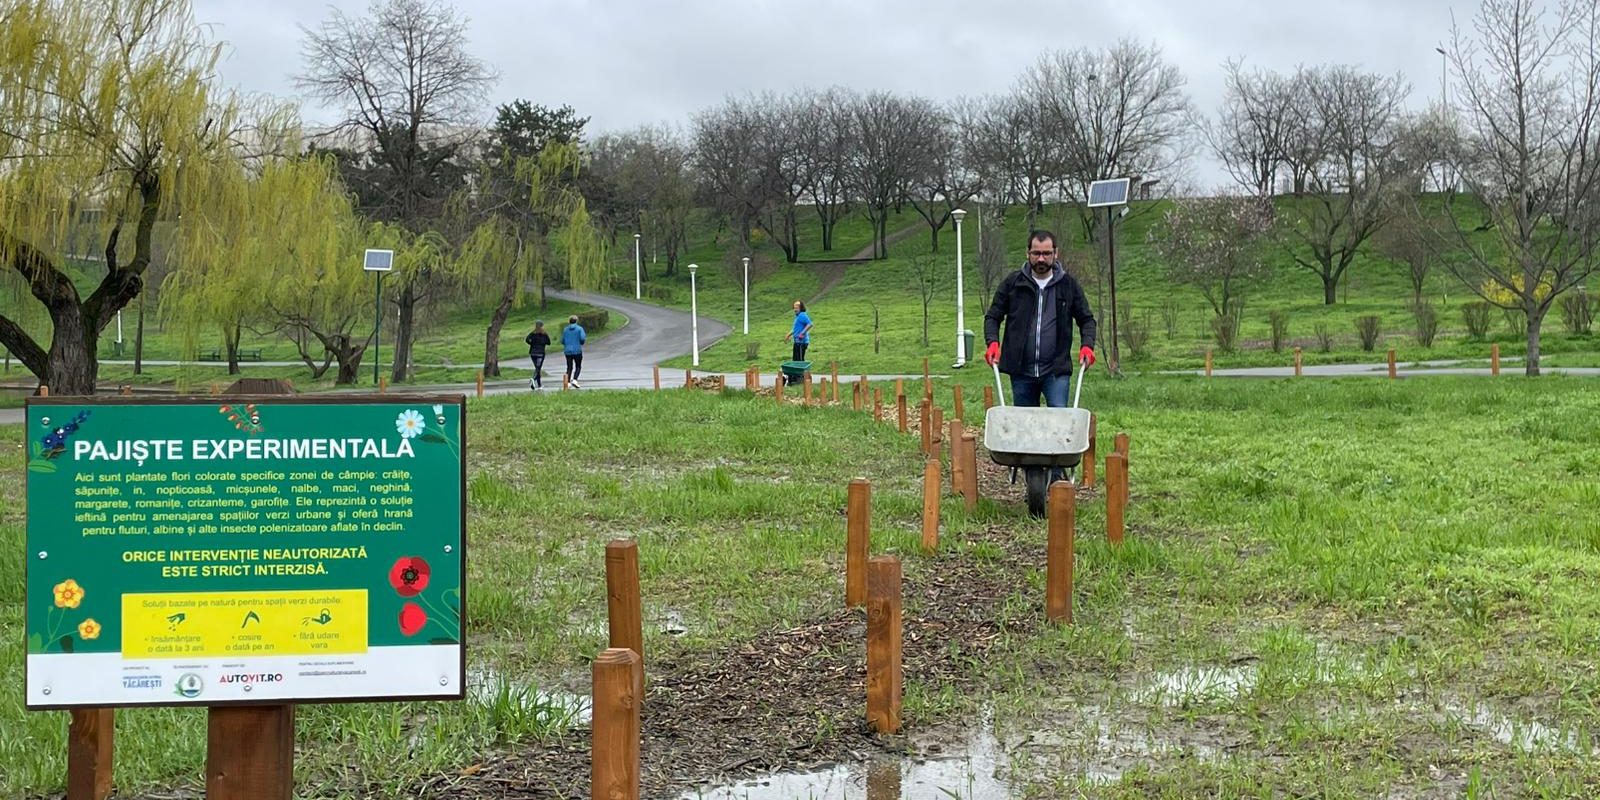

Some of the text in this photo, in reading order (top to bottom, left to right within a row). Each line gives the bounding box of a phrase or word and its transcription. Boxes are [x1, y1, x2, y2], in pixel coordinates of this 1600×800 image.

[74, 440, 184, 467] PAJIȘTE
[75, 473, 94, 482] Aici
[99, 473, 122, 482] sunt
[125, 472, 167, 483] plantate
[171, 472, 190, 481] flori
[195, 472, 236, 481] colorate
[240, 471, 285, 482] specifice
[289, 471, 317, 480] zonei
[321, 471, 334, 480] de
[296, 496, 313, 506] Ele
[316, 495, 366, 508] reprezintă
[380, 495, 413, 506] soluție
[75, 508, 413, 524] ieftină pentru amenajarea spațiilor verzi urbane și oferă hrană
[82, 526, 116, 537] pentru
[153, 525, 184, 535] albine
[187, 525, 196, 537] și
[198, 525, 218, 534] alte
[220, 524, 257, 534] insecte
[259, 523, 328, 535] polenizatoare
[330, 522, 359, 532] aflate
[361, 522, 371, 532] în
[122, 546, 368, 563] ORICE INTERVENȚIE NEAUTORIZATĂ
[162, 562, 329, 577] ESTE STRICT INTERZISĂ.
[220, 673, 283, 683] AUTOVIT.RO
